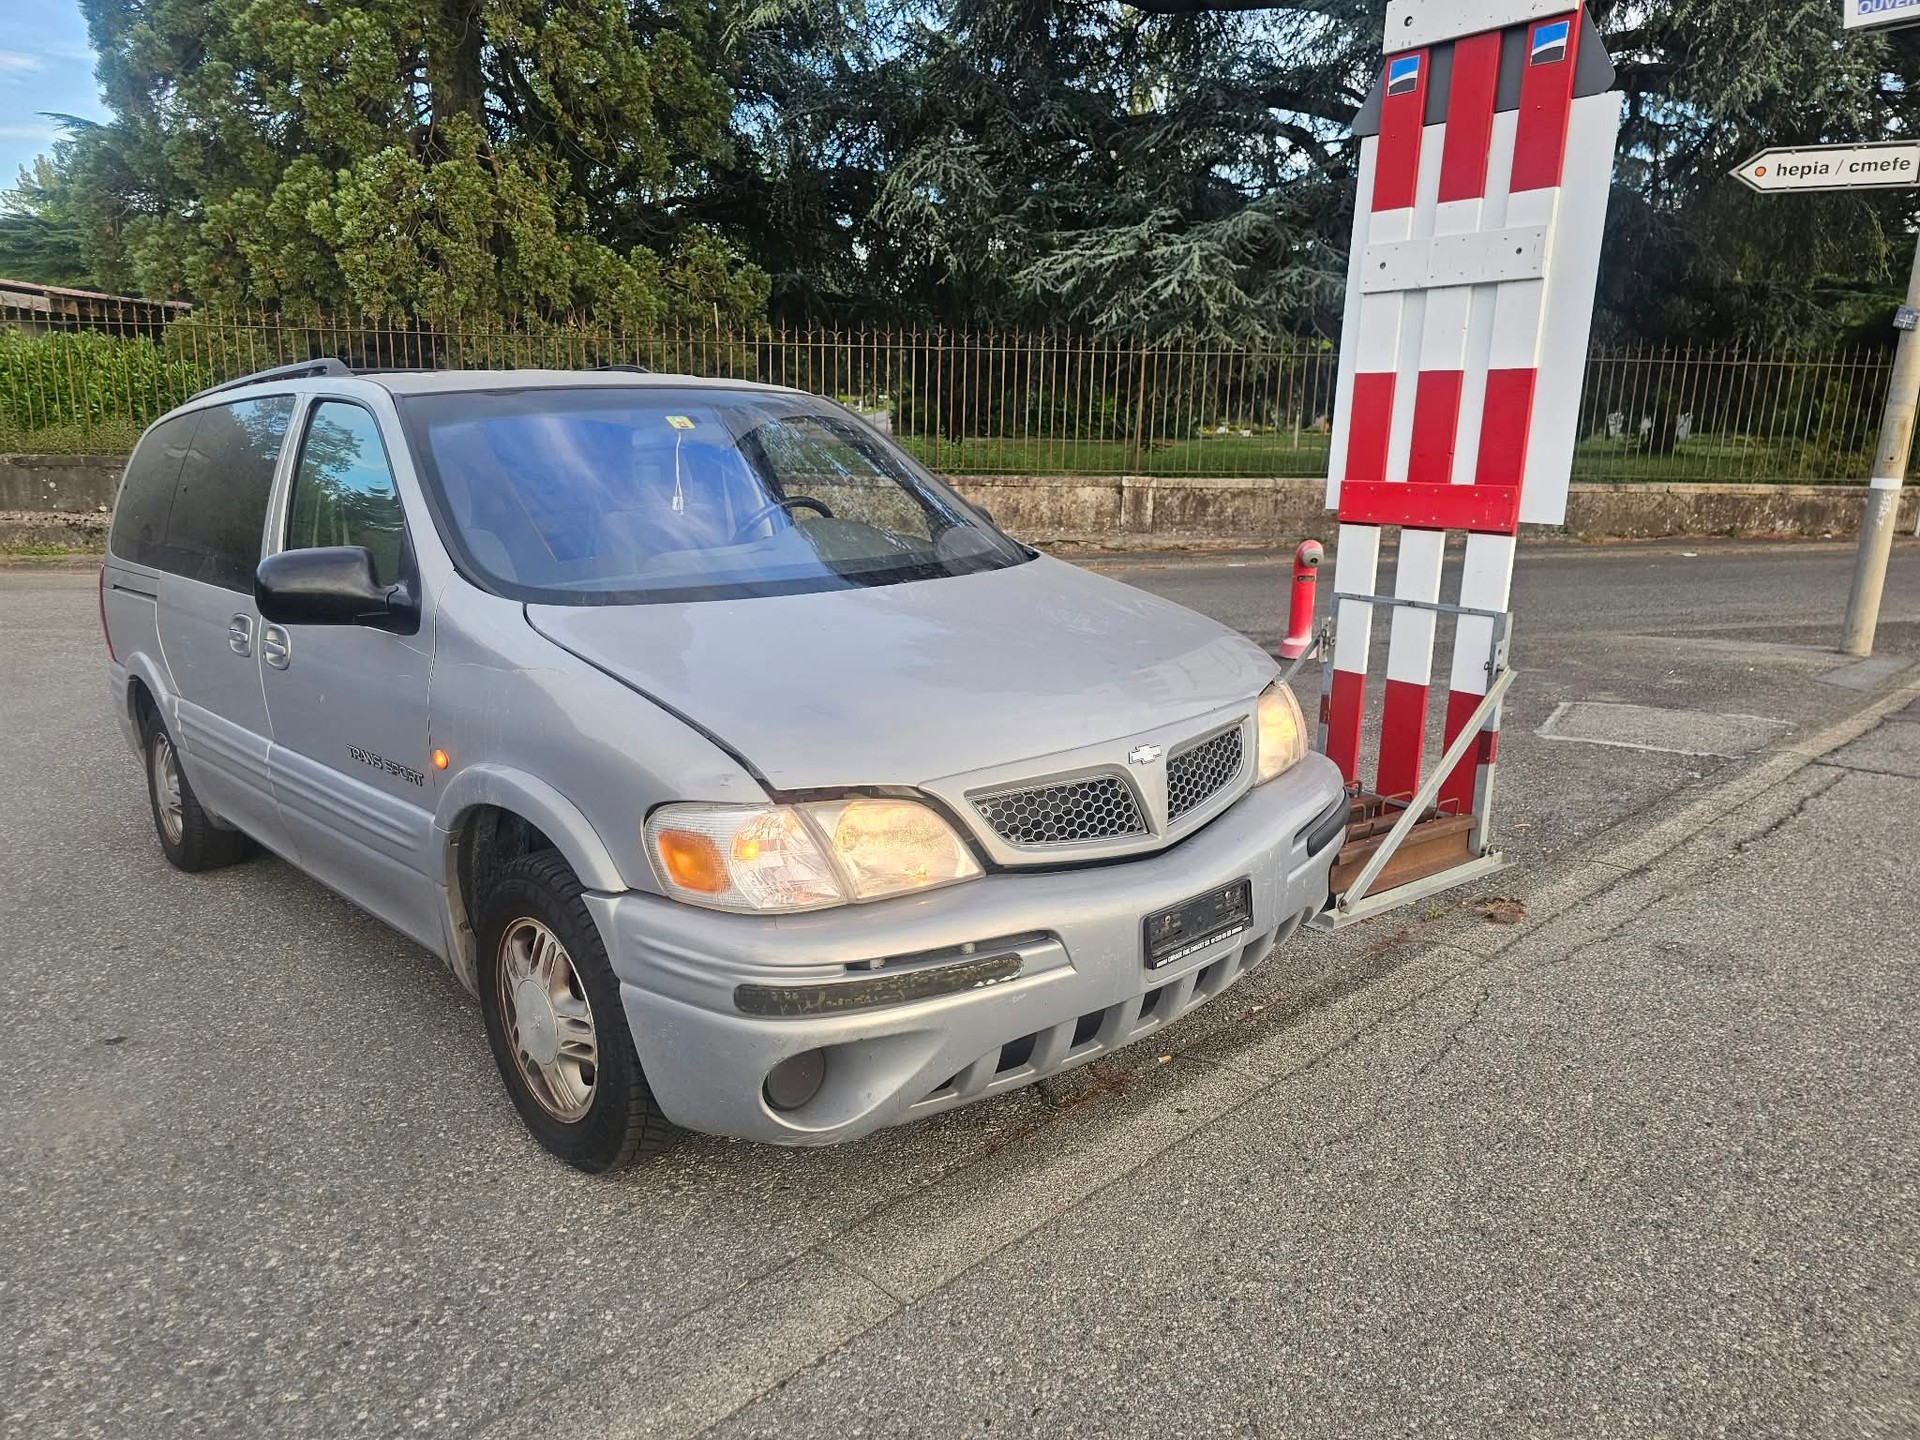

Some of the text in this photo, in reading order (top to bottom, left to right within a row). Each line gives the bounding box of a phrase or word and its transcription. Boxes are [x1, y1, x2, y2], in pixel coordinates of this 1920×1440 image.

[1776, 157, 1911, 179] hepia / cmefe
[346, 743, 383, 770] TRANS
